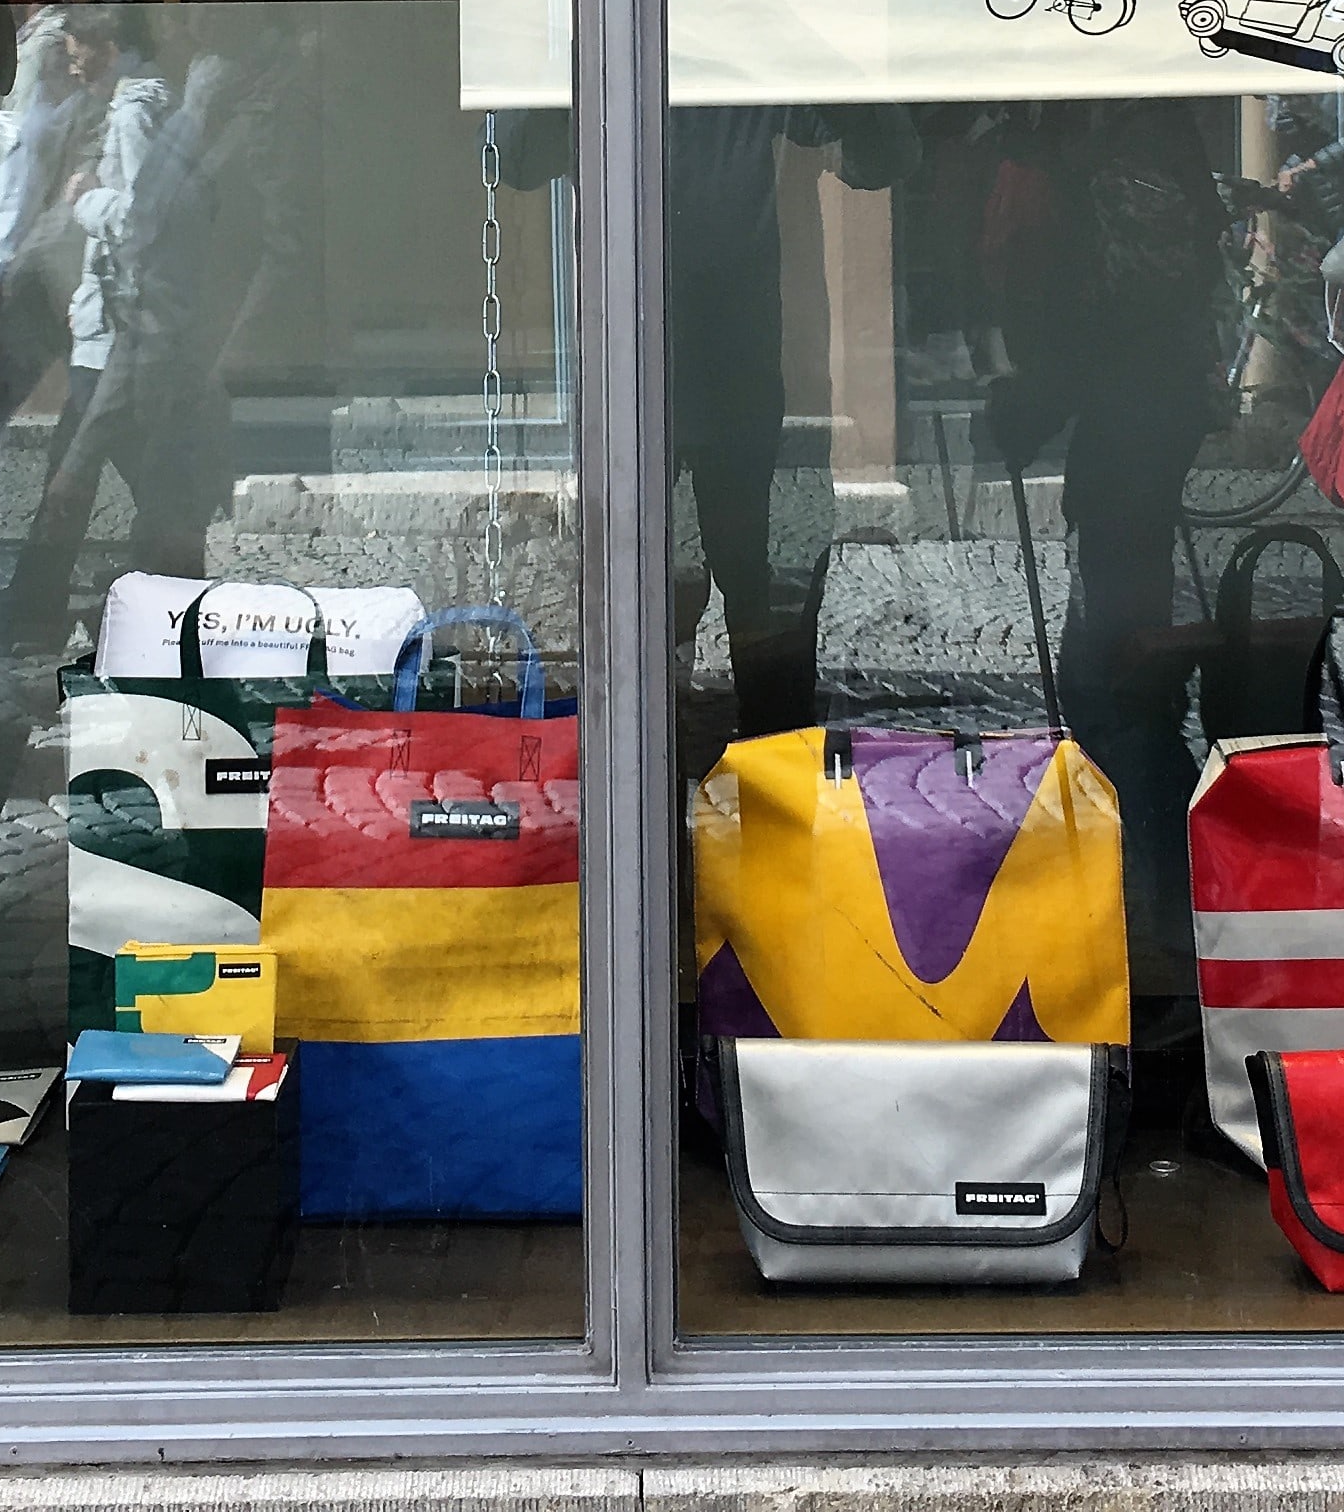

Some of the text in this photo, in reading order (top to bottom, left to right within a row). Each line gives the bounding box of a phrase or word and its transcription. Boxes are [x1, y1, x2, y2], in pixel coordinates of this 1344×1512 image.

[235, 613, 275, 632] I'M
[217, 771, 271, 781] FREIT
[421, 813, 507, 826] FREITAG
[965, 1193, 1037, 1204] FREITAG
